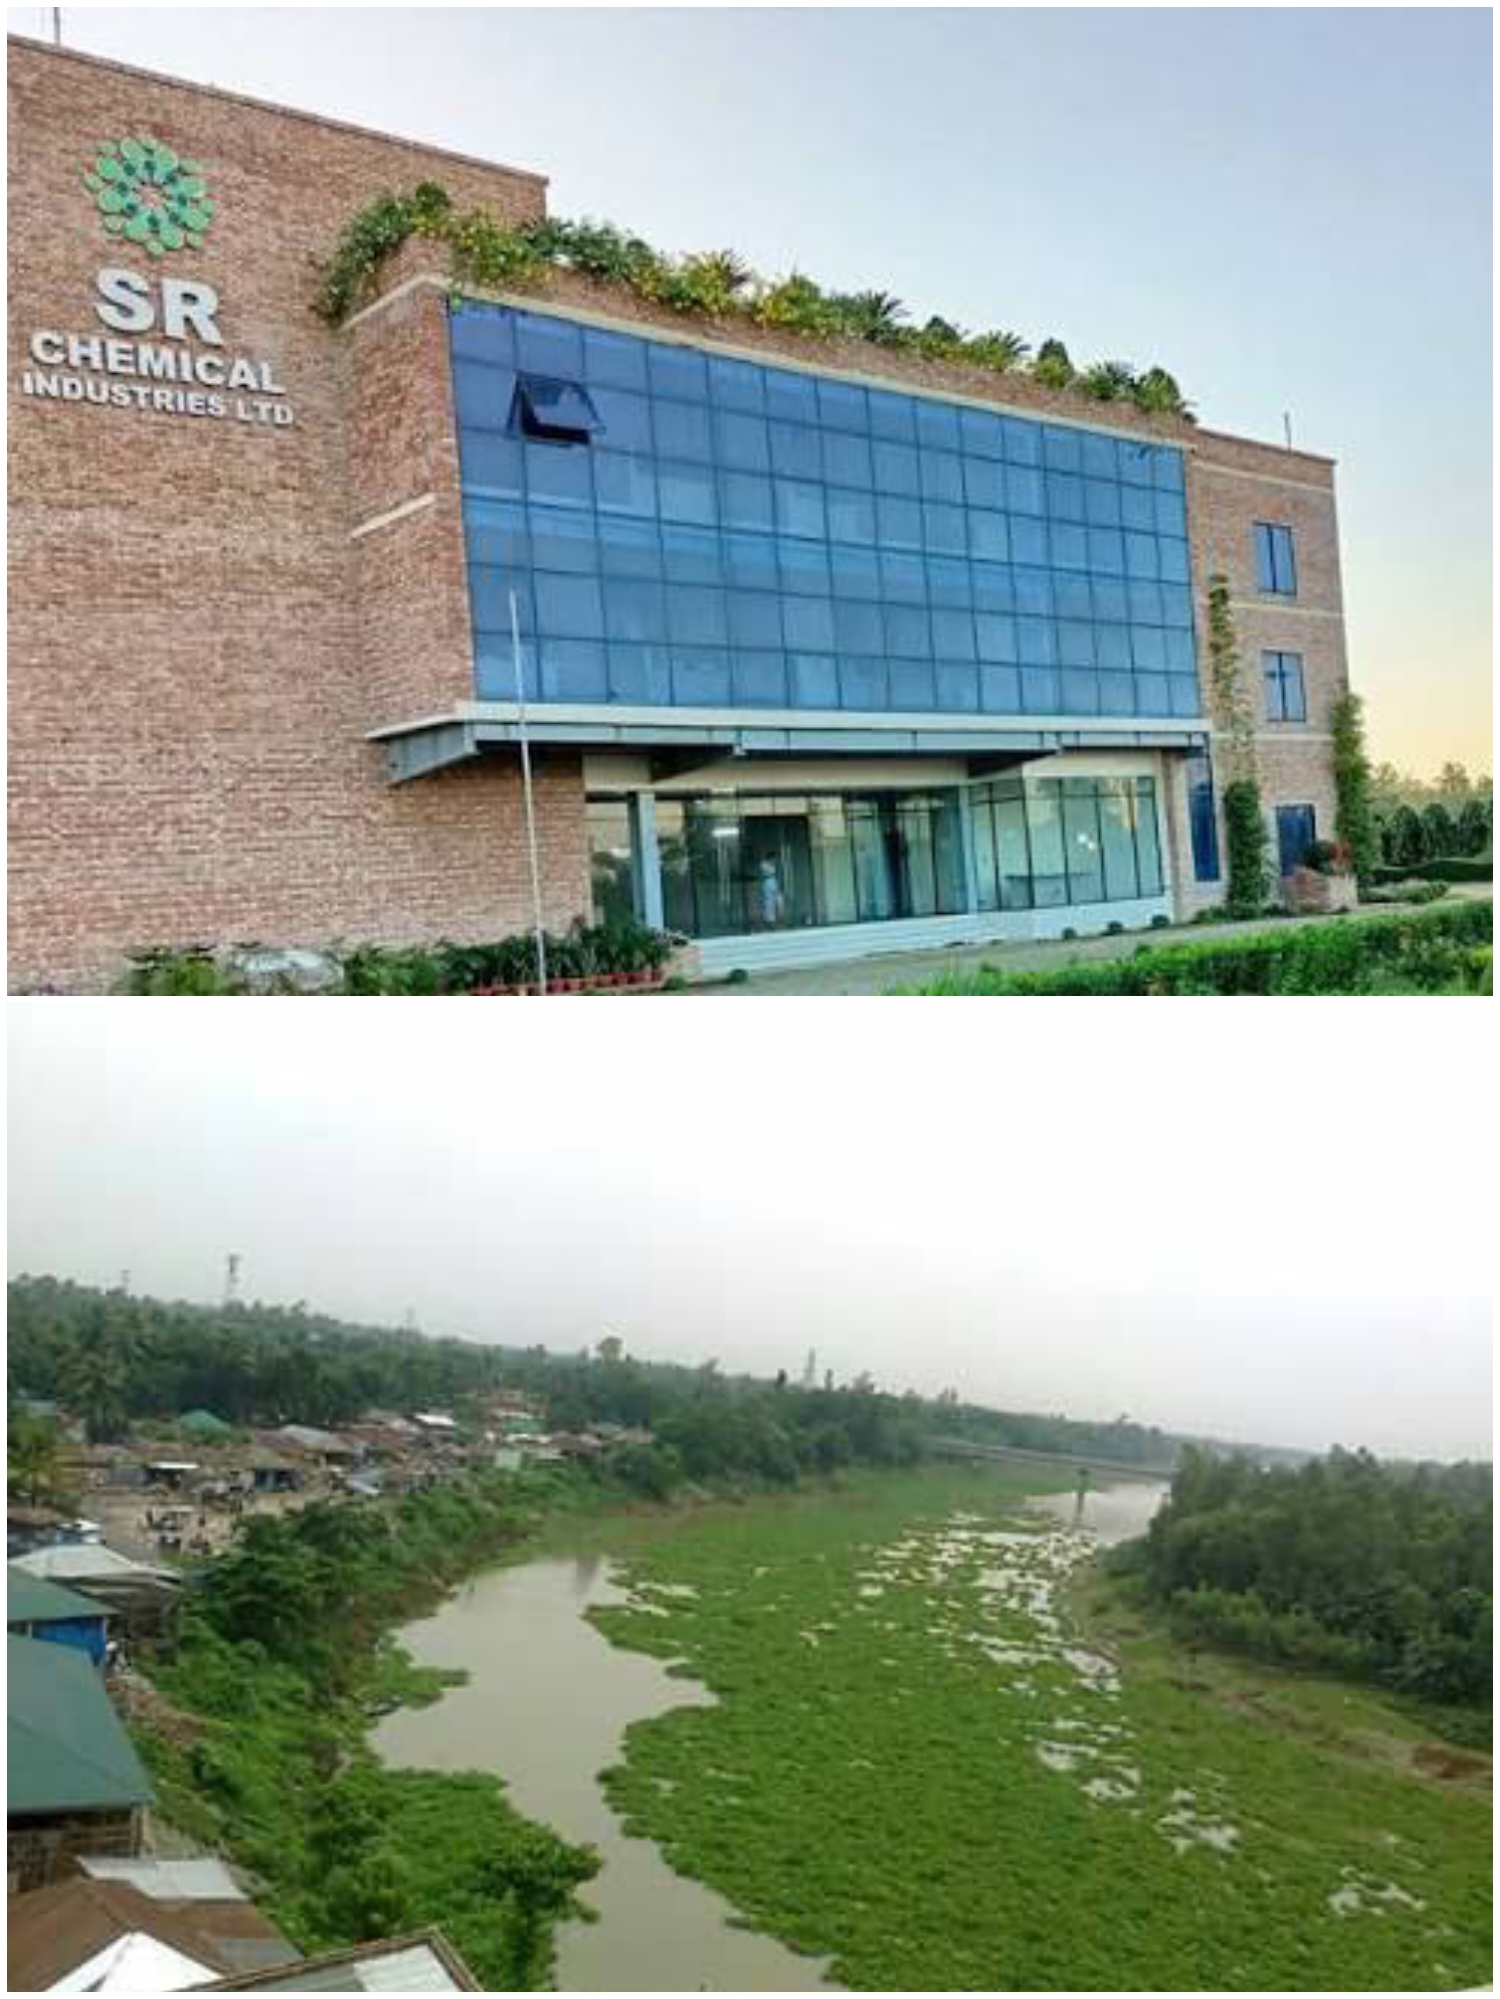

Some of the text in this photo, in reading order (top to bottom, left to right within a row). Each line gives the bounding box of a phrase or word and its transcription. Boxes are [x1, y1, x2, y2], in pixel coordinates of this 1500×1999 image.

[95, 267, 223, 346] SR
[30, 331, 286, 395] CHEMICAL
[22, 371, 294, 425] INDUSTRIES LTD
